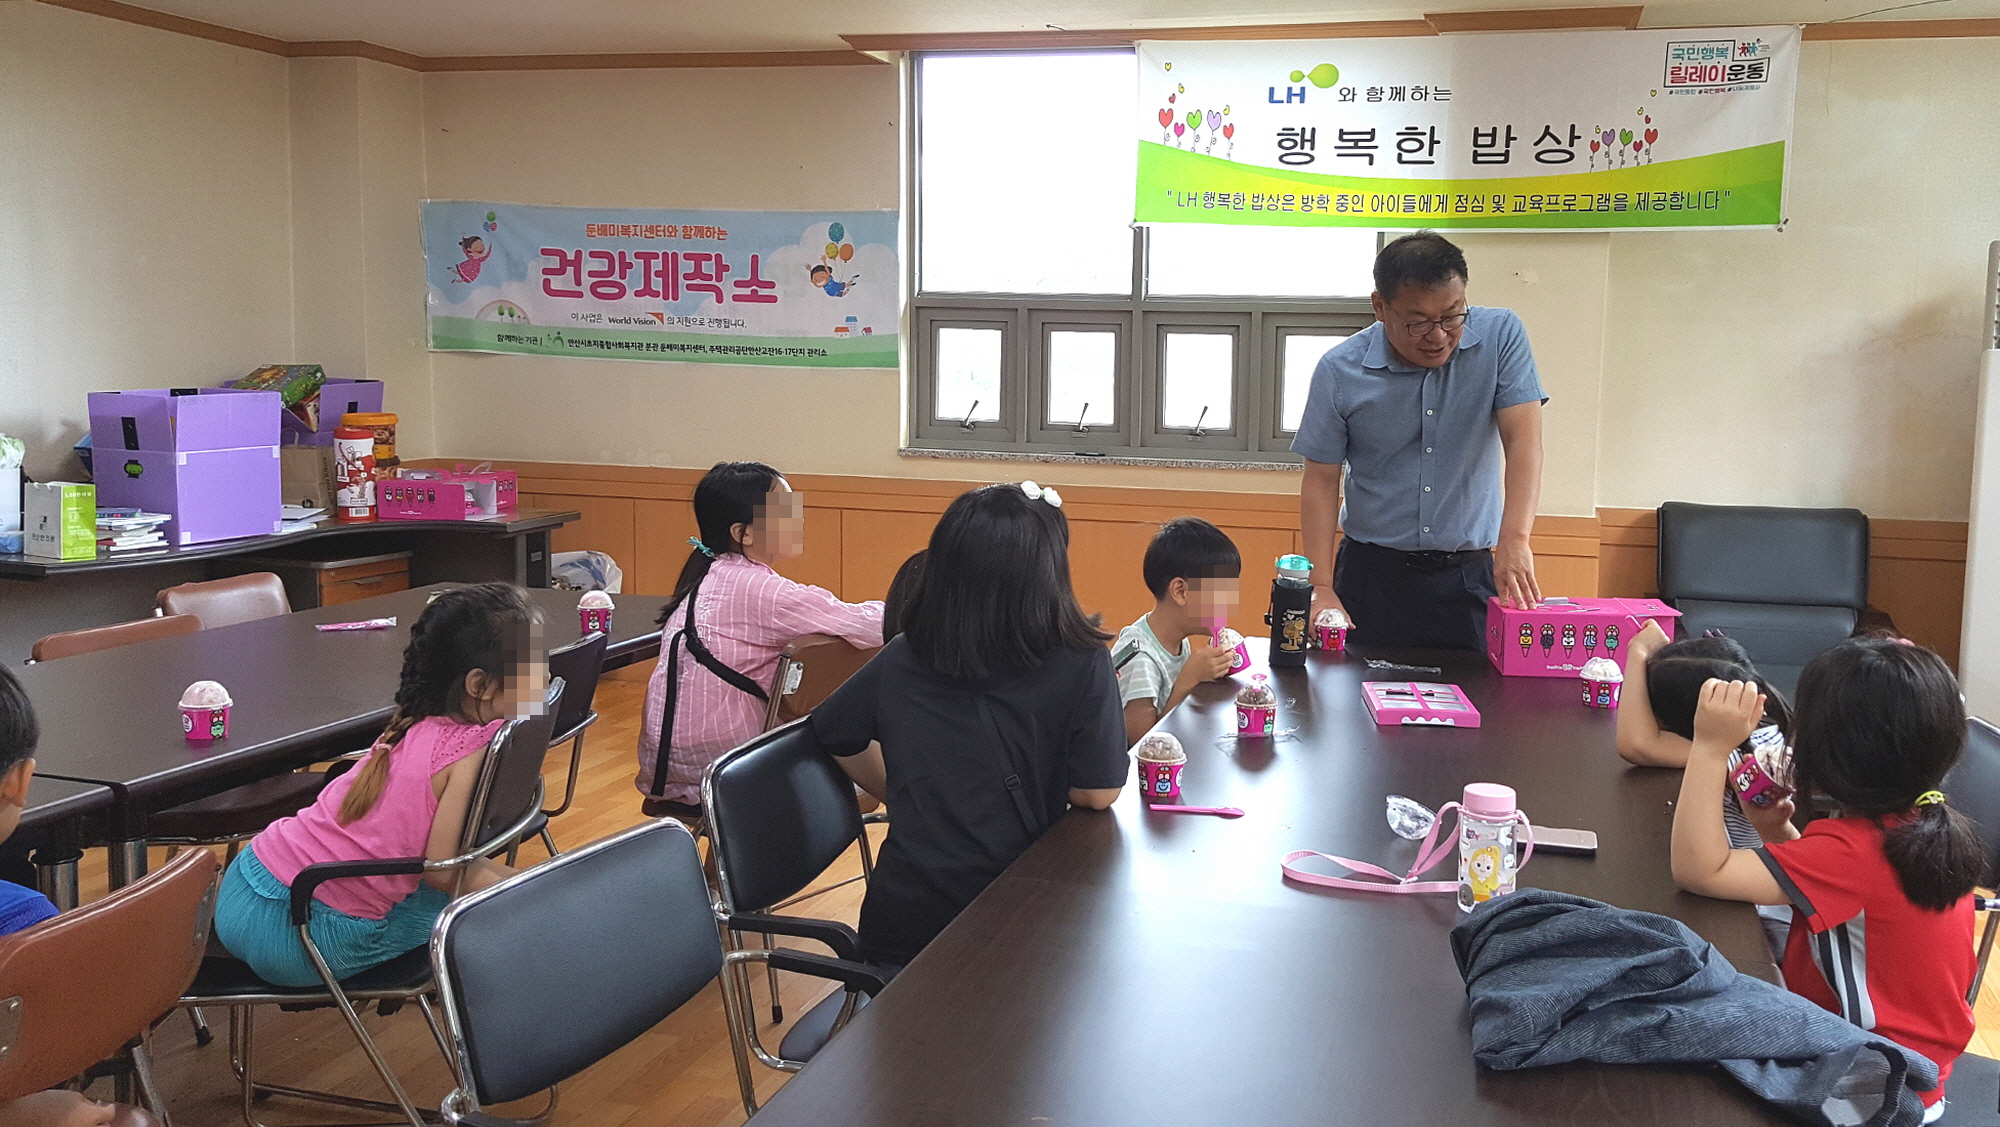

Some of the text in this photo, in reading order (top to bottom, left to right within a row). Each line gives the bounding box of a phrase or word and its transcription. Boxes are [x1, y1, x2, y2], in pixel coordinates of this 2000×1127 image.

[1672, 45, 1729, 61] 국민행복
[1670, 62, 1765, 84] 릴레이운동
[1268, 86, 1452, 104] LH 와 함께하는
[1277, 124, 1582, 166] 행복한 밥상
[1203, 191, 1246, 210] 행복한
[1252, 192, 1295, 212] 밥상은
[1301, 194, 1330, 212] 방학
[1335, 194, 1364, 213] 중인
[1371, 194, 1448, 213] 아이들에게
[1454, 193, 1485, 214] 점심
[1492, 194, 1506, 213] 및
[1512, 191, 1629, 213] 교육프로그램을
[585, 222, 728, 241] 둔배미복지센터와 함께하는
[540, 247, 778, 304] 건강제작소
[571, 312, 747, 328] 이 사업은 World Vision 의 지원으로 진행됩니다.
[497, 333, 524, 344] 함께하는
[526, 336, 538, 345] 기관
[807, 348, 828, 357] 관리소
